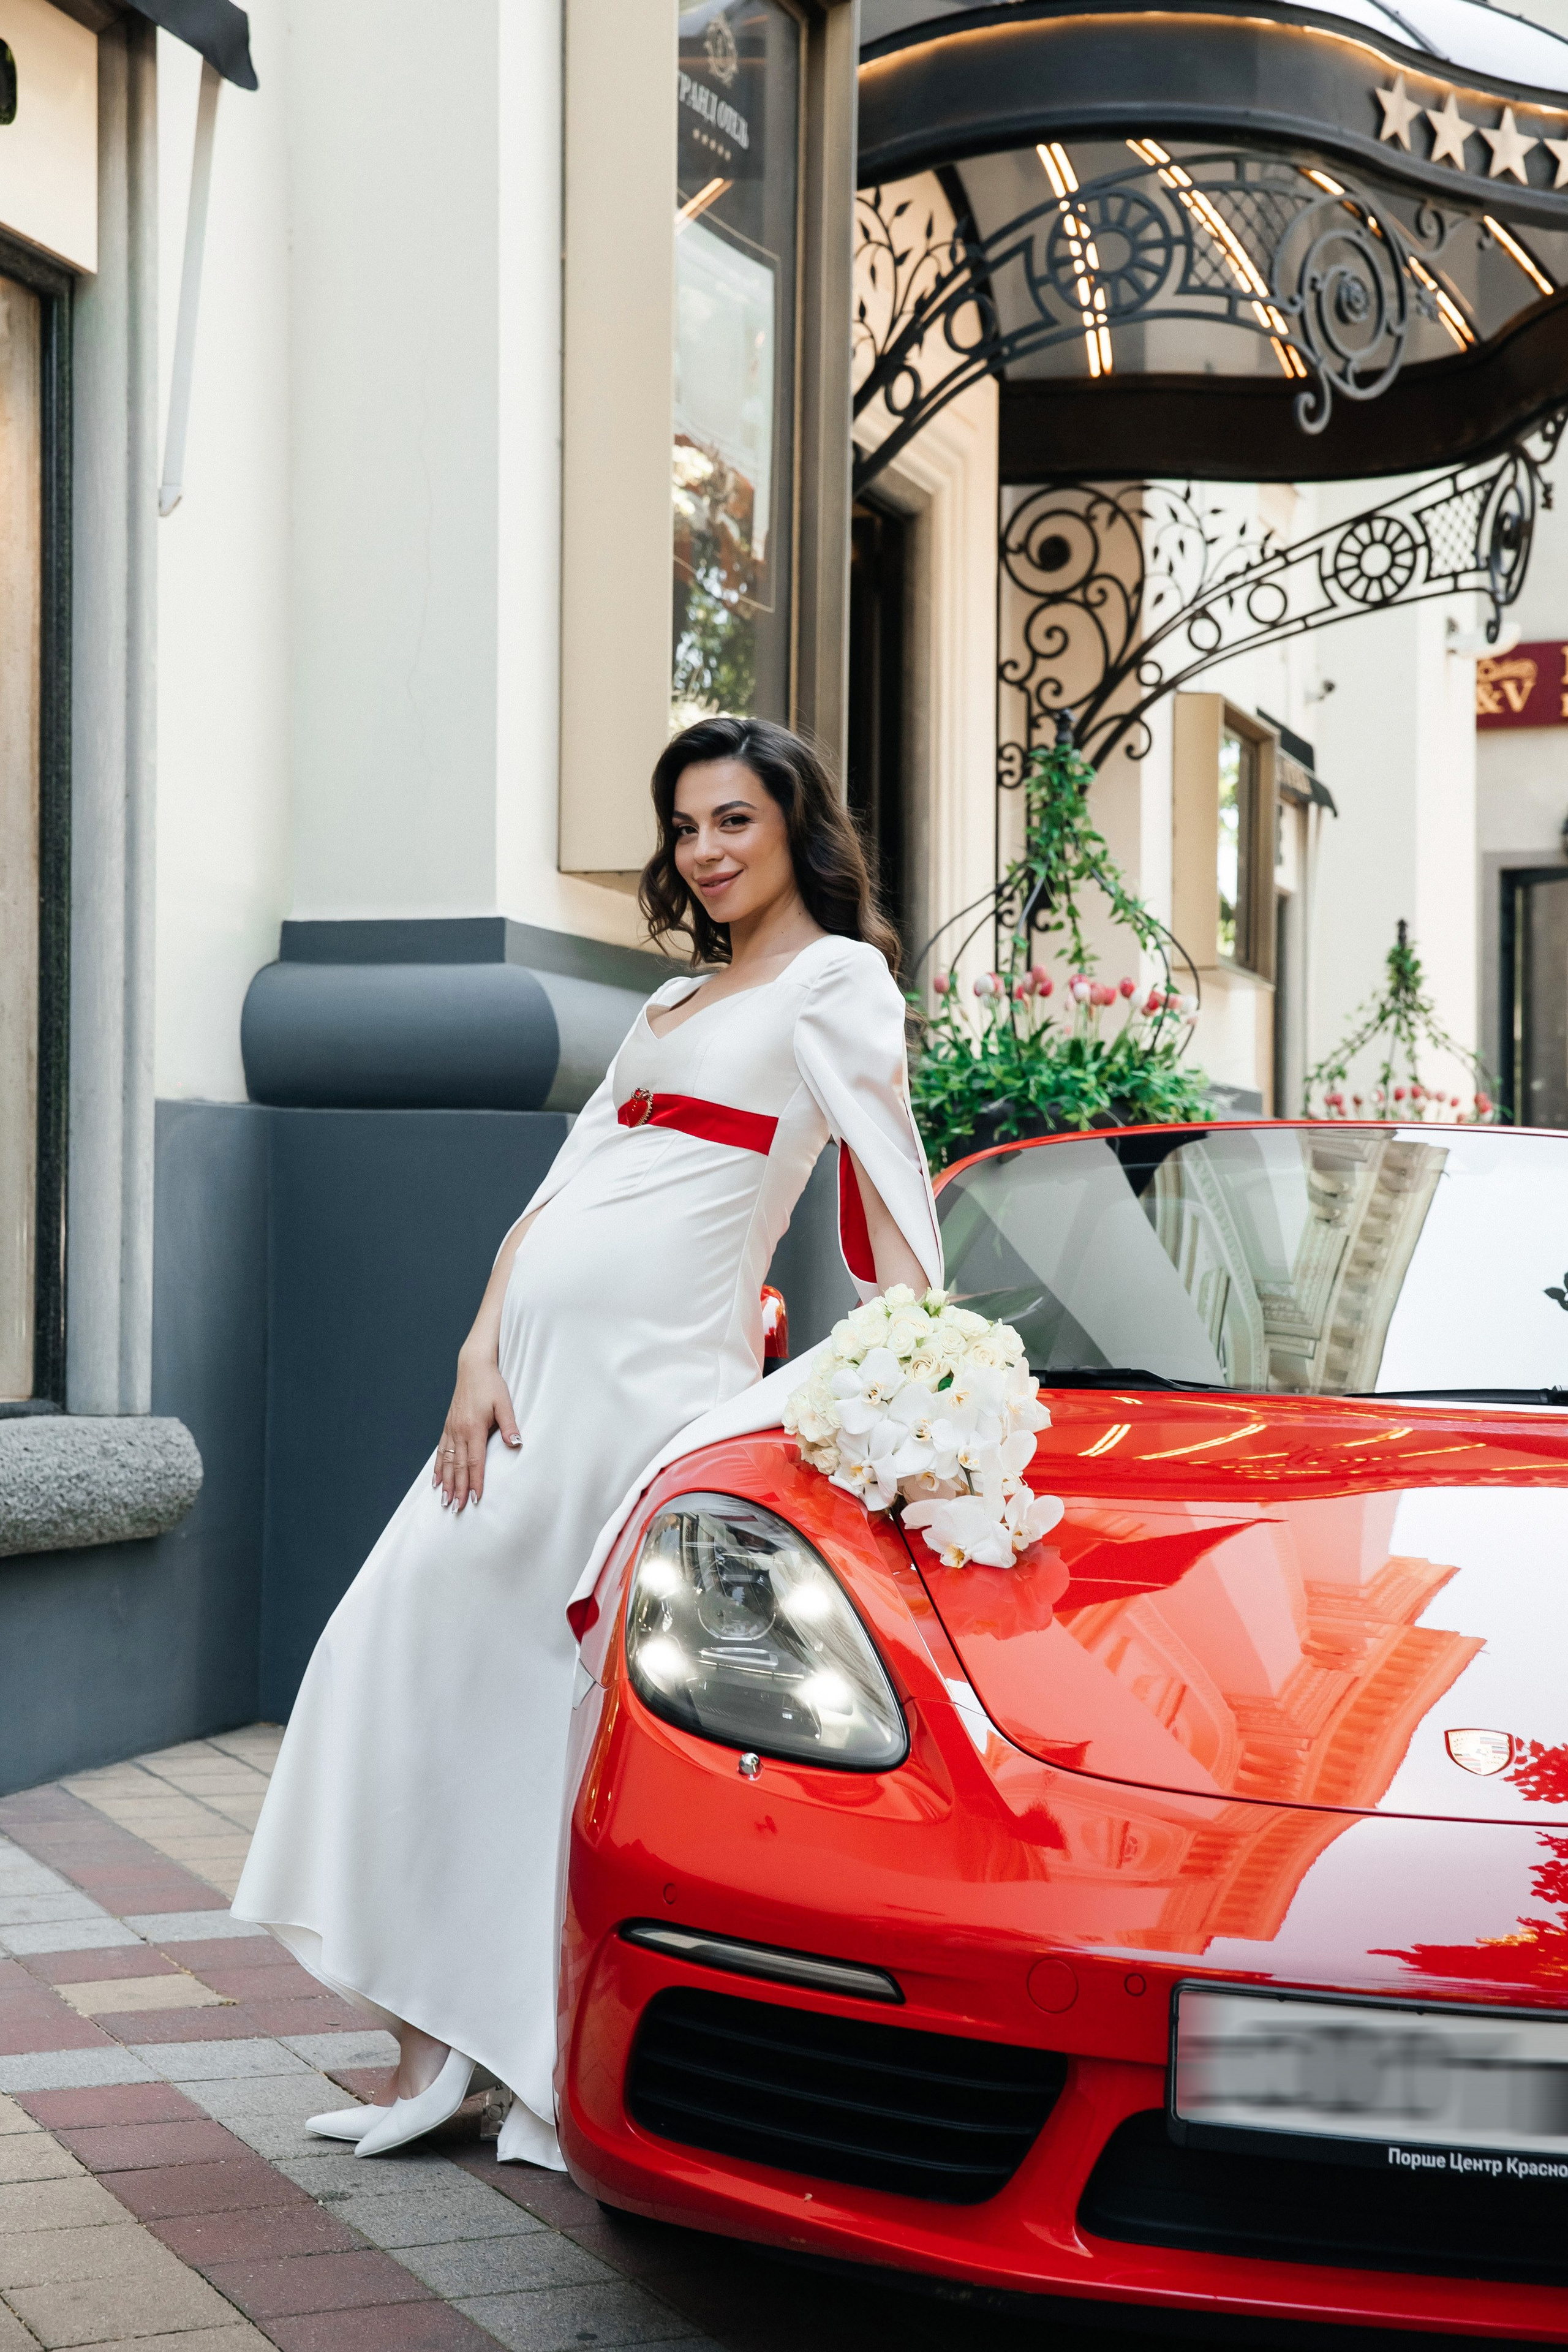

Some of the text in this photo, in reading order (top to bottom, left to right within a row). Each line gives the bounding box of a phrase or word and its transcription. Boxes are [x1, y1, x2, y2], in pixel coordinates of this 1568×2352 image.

[1388, 2147, 1568, 2179] Порше Центр Красно
